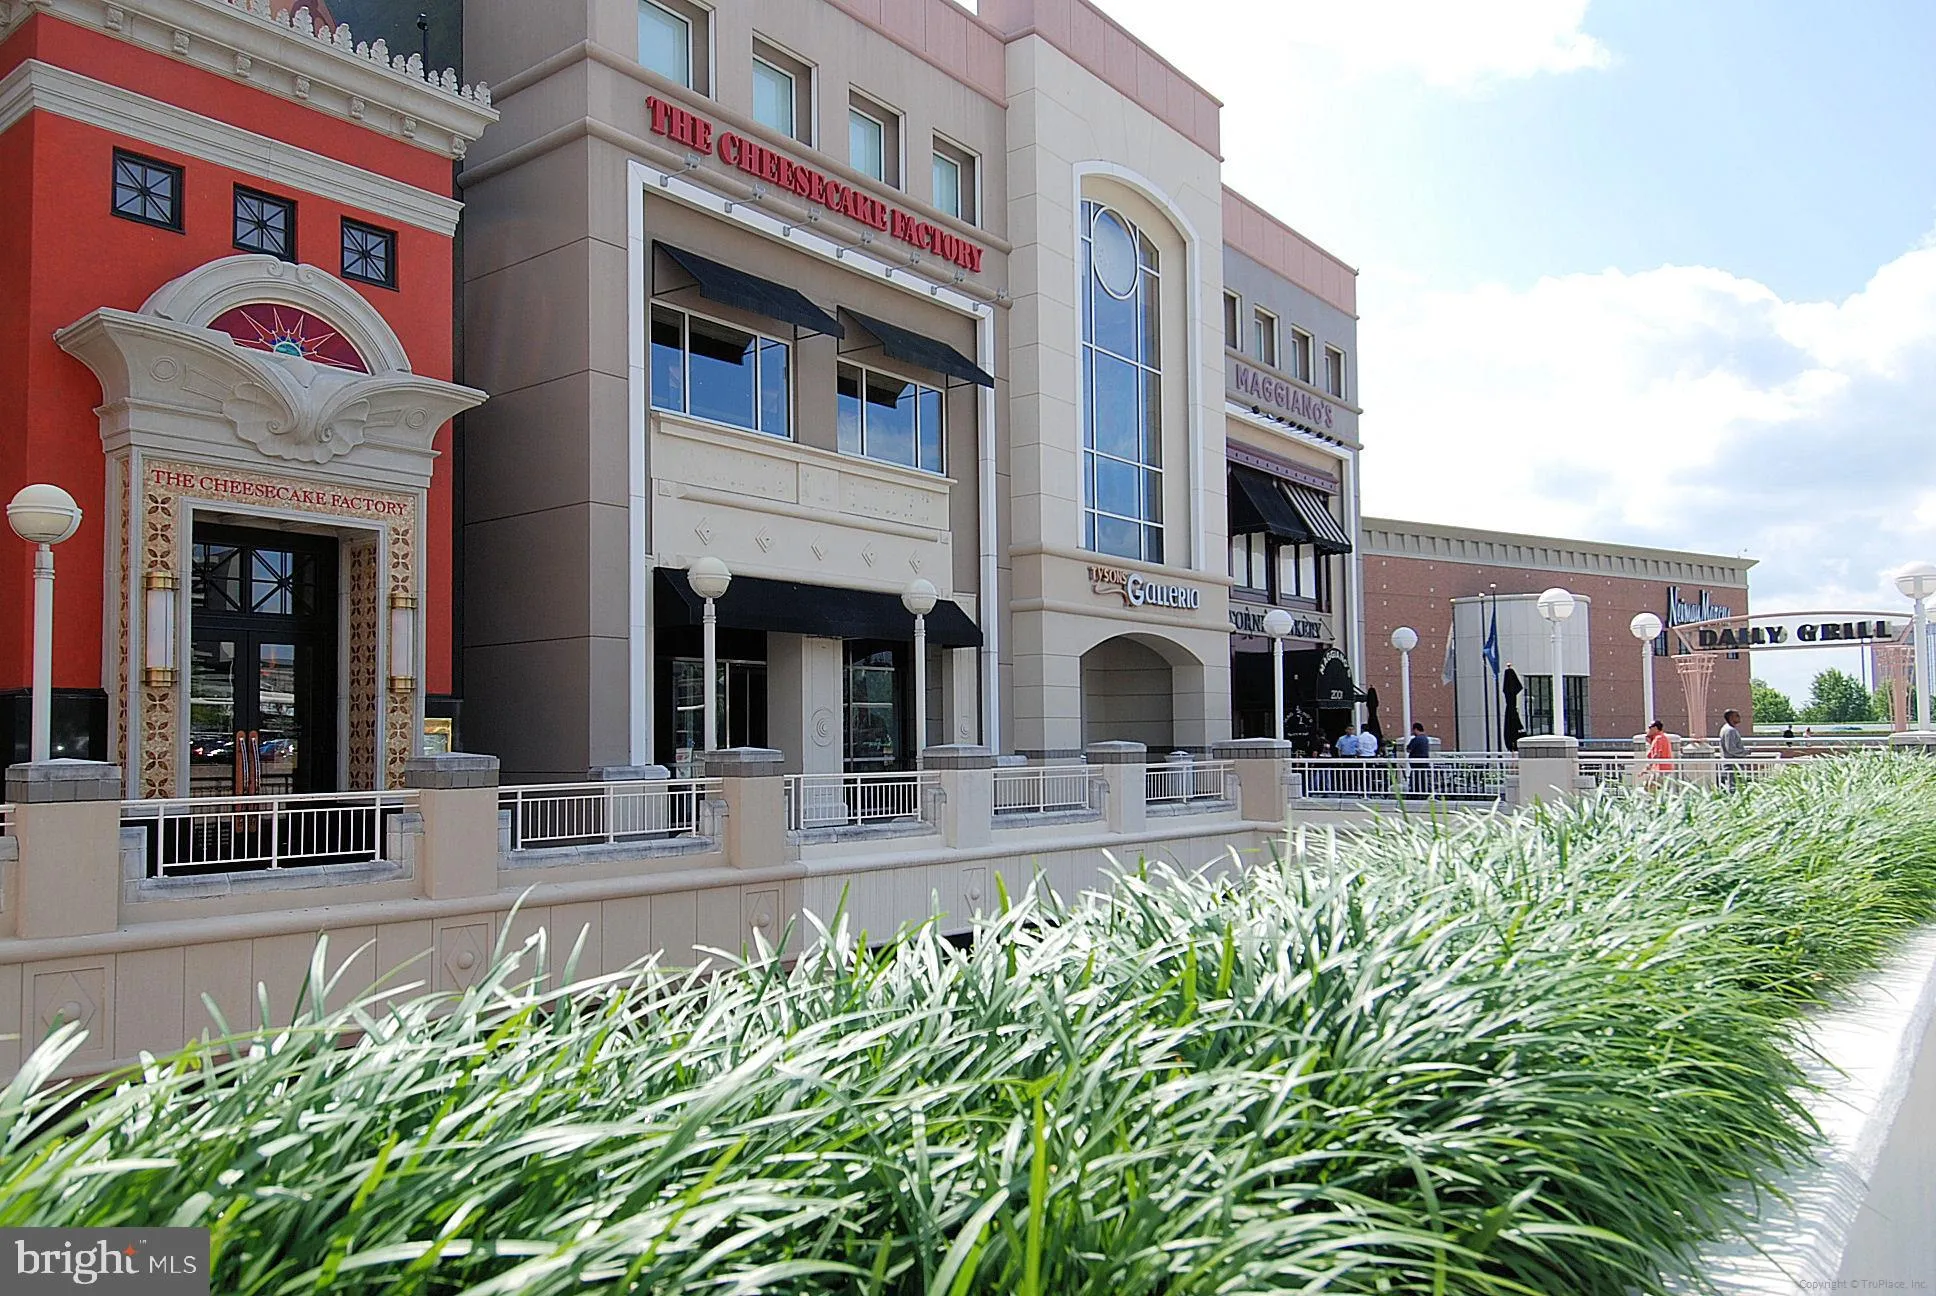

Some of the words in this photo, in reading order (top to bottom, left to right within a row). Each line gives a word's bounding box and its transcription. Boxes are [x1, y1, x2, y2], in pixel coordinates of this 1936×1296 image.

[646, 95, 712, 155] THE
[717, 131, 887, 232] CHEESECAKE
[890, 208, 984, 273] FACTORY
[1235, 363, 1333, 429] MAGGIANO'S
[151, 469, 195, 488] THE
[200, 476, 327, 506] CHEESECAKE
[331, 494, 408, 516] FACTORY
[1087, 565, 1128, 586] TYSONS
[1700, 626, 1786, 647] DAILY
[1796, 620, 1892, 642] GRILL
